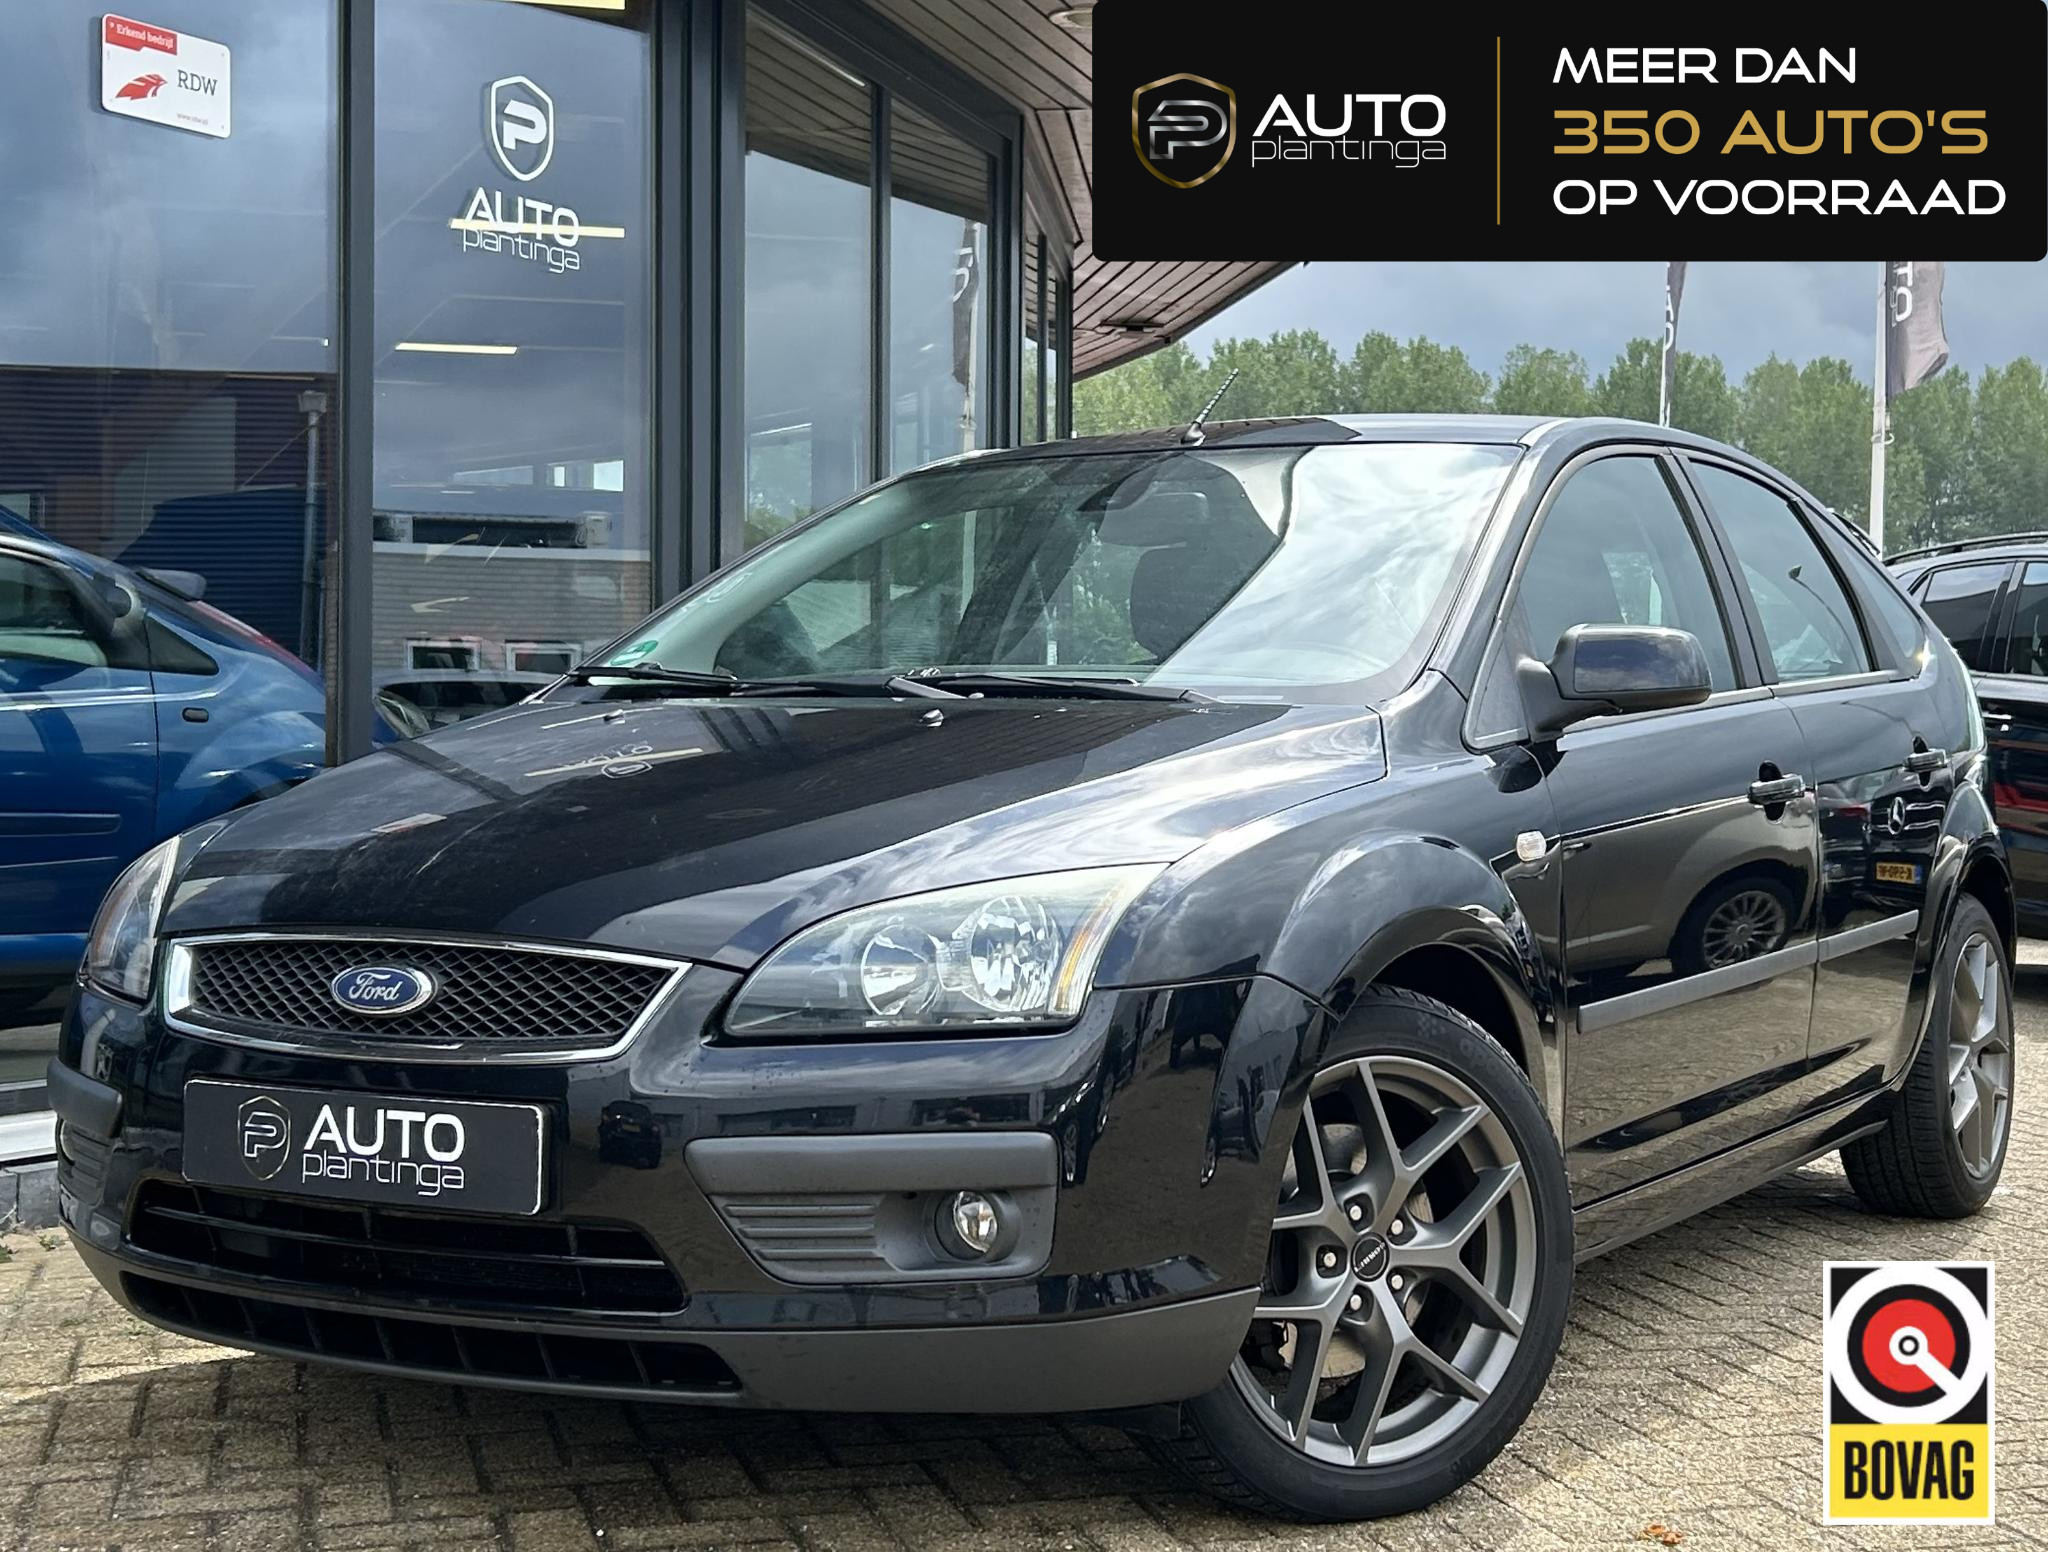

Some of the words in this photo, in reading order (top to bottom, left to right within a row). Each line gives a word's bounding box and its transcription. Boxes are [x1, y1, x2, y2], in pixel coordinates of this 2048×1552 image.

[177, 69, 218, 96] RDW
[463, 186, 580, 247] AUTO
[463, 226, 580, 274] plantinga
[348, 973, 402, 1001] Ford
[304, 1104, 465, 1162] AUTO
[302, 1150, 465, 1196] plantinga
